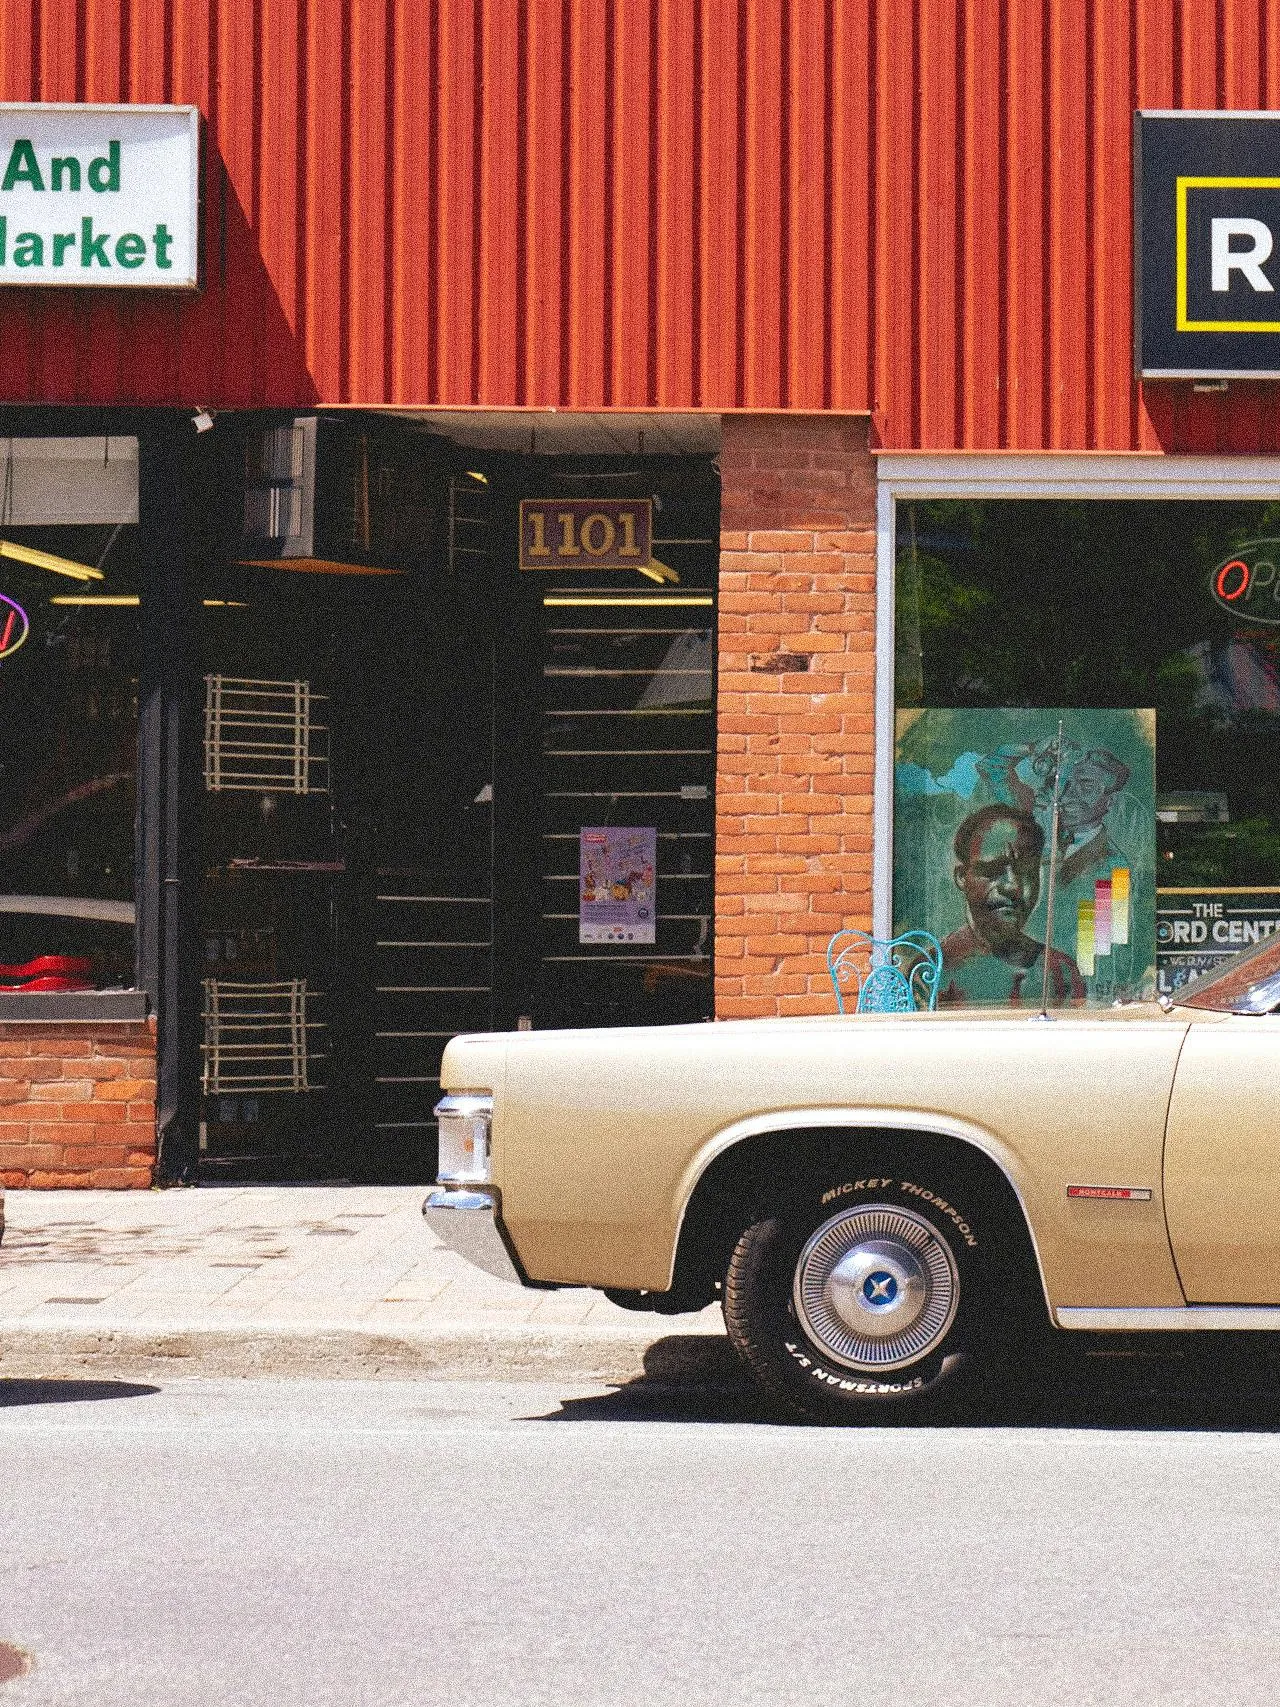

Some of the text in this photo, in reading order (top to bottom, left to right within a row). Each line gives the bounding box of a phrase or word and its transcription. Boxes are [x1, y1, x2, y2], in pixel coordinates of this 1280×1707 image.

[1, 139, 121, 193] And
[0, 216, 174, 270] arket
[526, 513, 642, 557] 1101
[1156, 920, 1208, 944] ORD
[1192, 902, 1224, 918] THE
[820, 1178, 979, 1248] MICKEY THOMPSON
[784, 1342, 925, 1395] SPORTSMAN S/T
